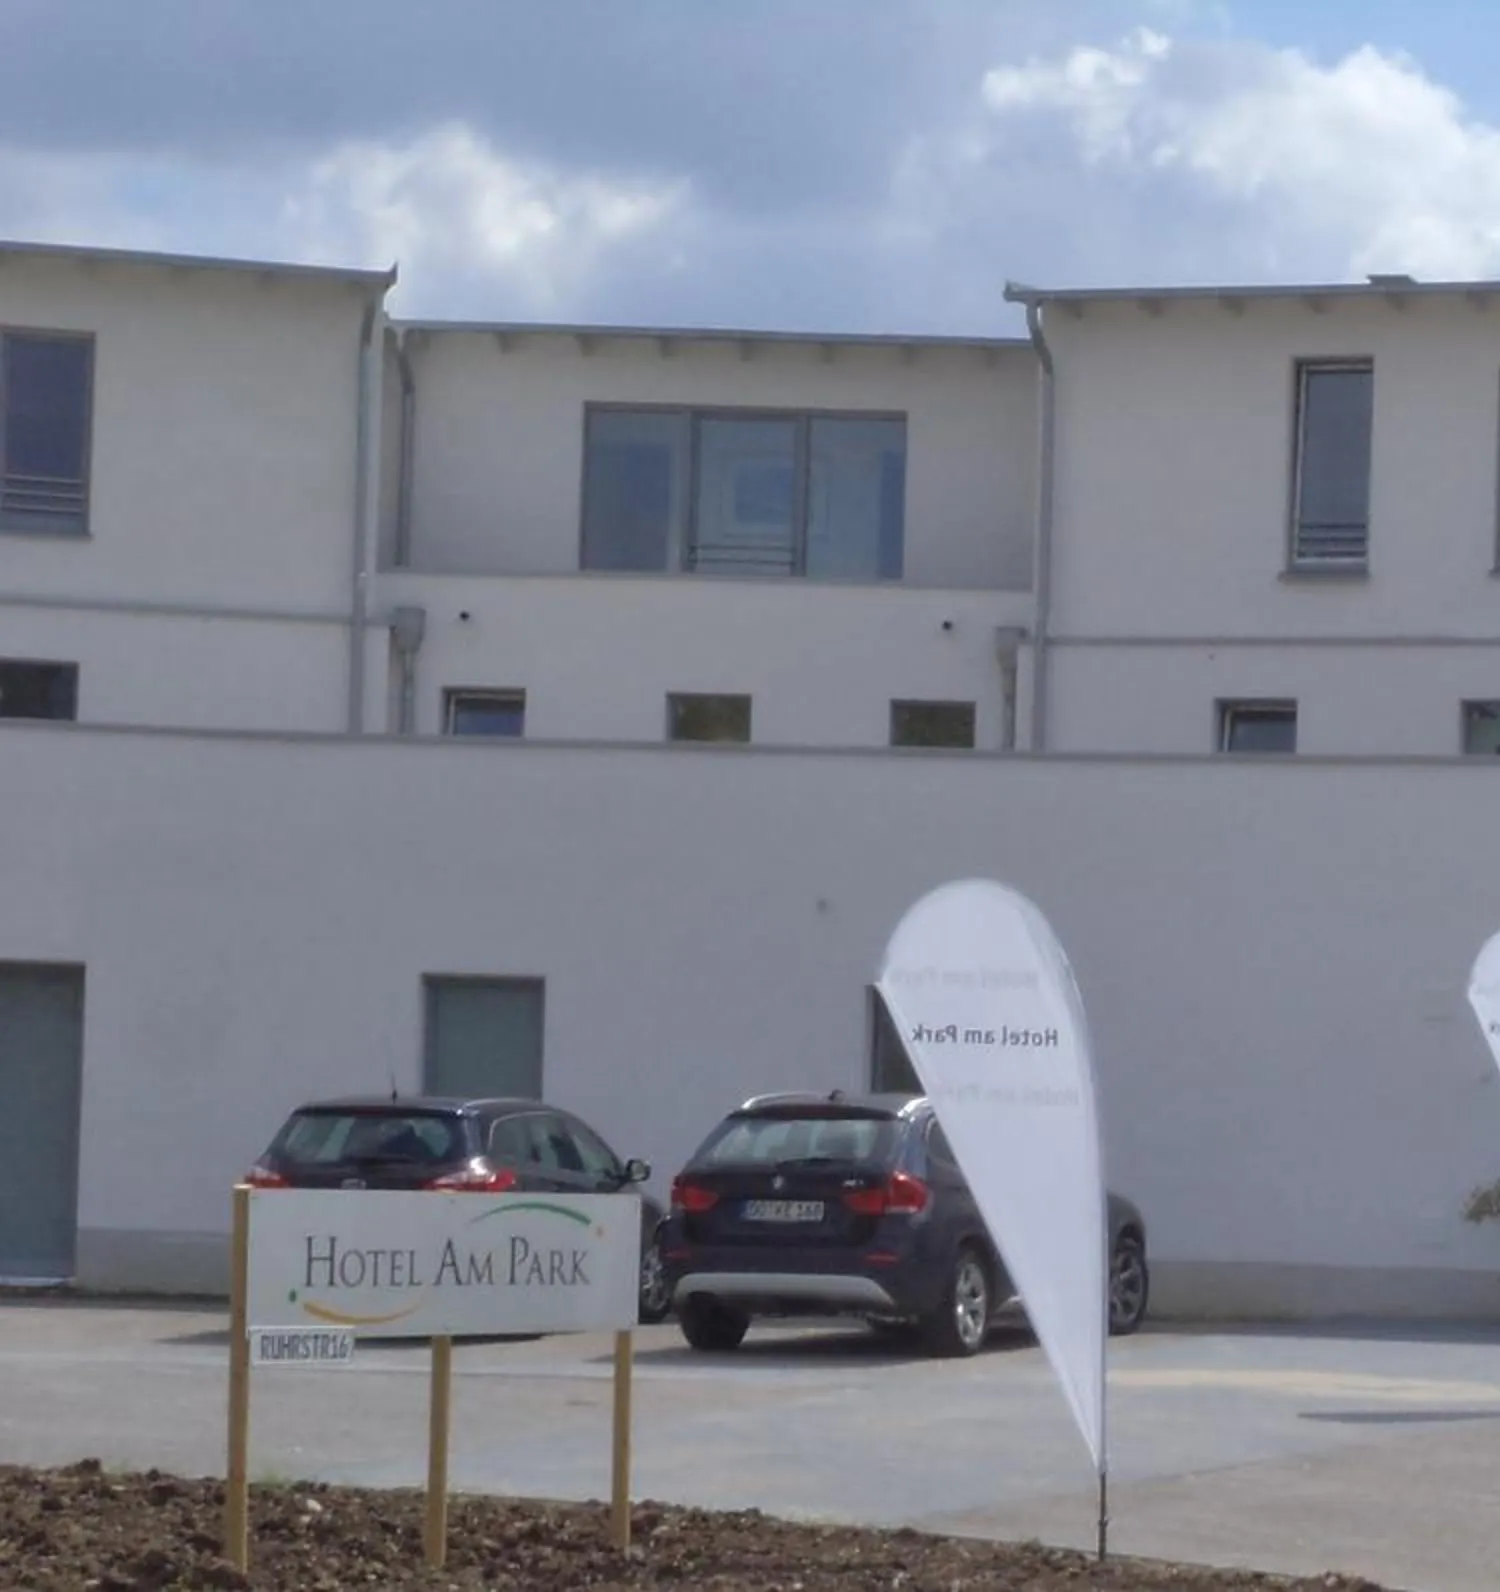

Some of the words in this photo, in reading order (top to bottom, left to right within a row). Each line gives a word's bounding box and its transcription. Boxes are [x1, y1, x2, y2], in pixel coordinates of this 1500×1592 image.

[304, 1234, 422, 1288] HOTEL
[433, 1237, 494, 1287] AM
[508, 1235, 591, 1287] PARK
